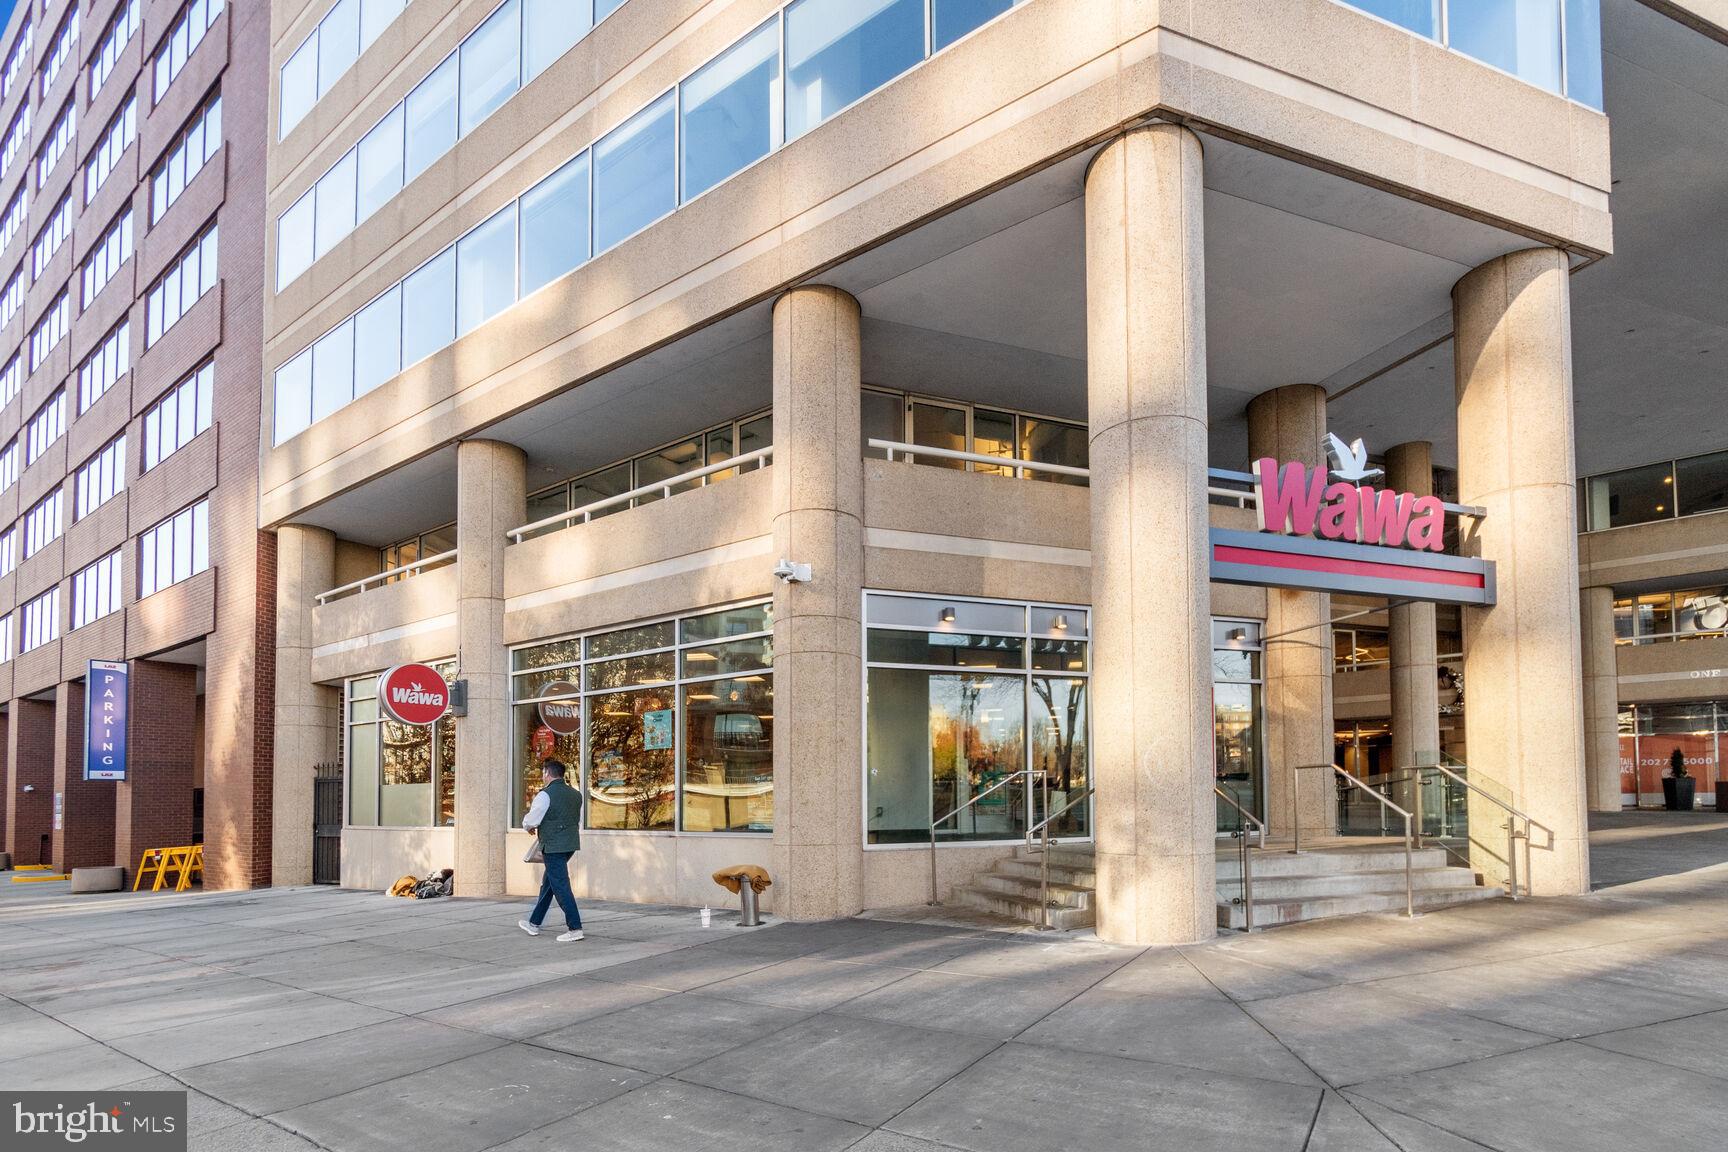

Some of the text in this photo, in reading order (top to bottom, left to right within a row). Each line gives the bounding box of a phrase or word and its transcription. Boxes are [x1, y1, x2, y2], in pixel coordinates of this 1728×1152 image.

[1252, 457, 1446, 552] Wawa
[1690, 669, 1721, 678] ONE
[392, 687, 444, 706] Wawa
[102, 675, 114, 765] PARKING
[1683, 757, 1713, 765] 5000
